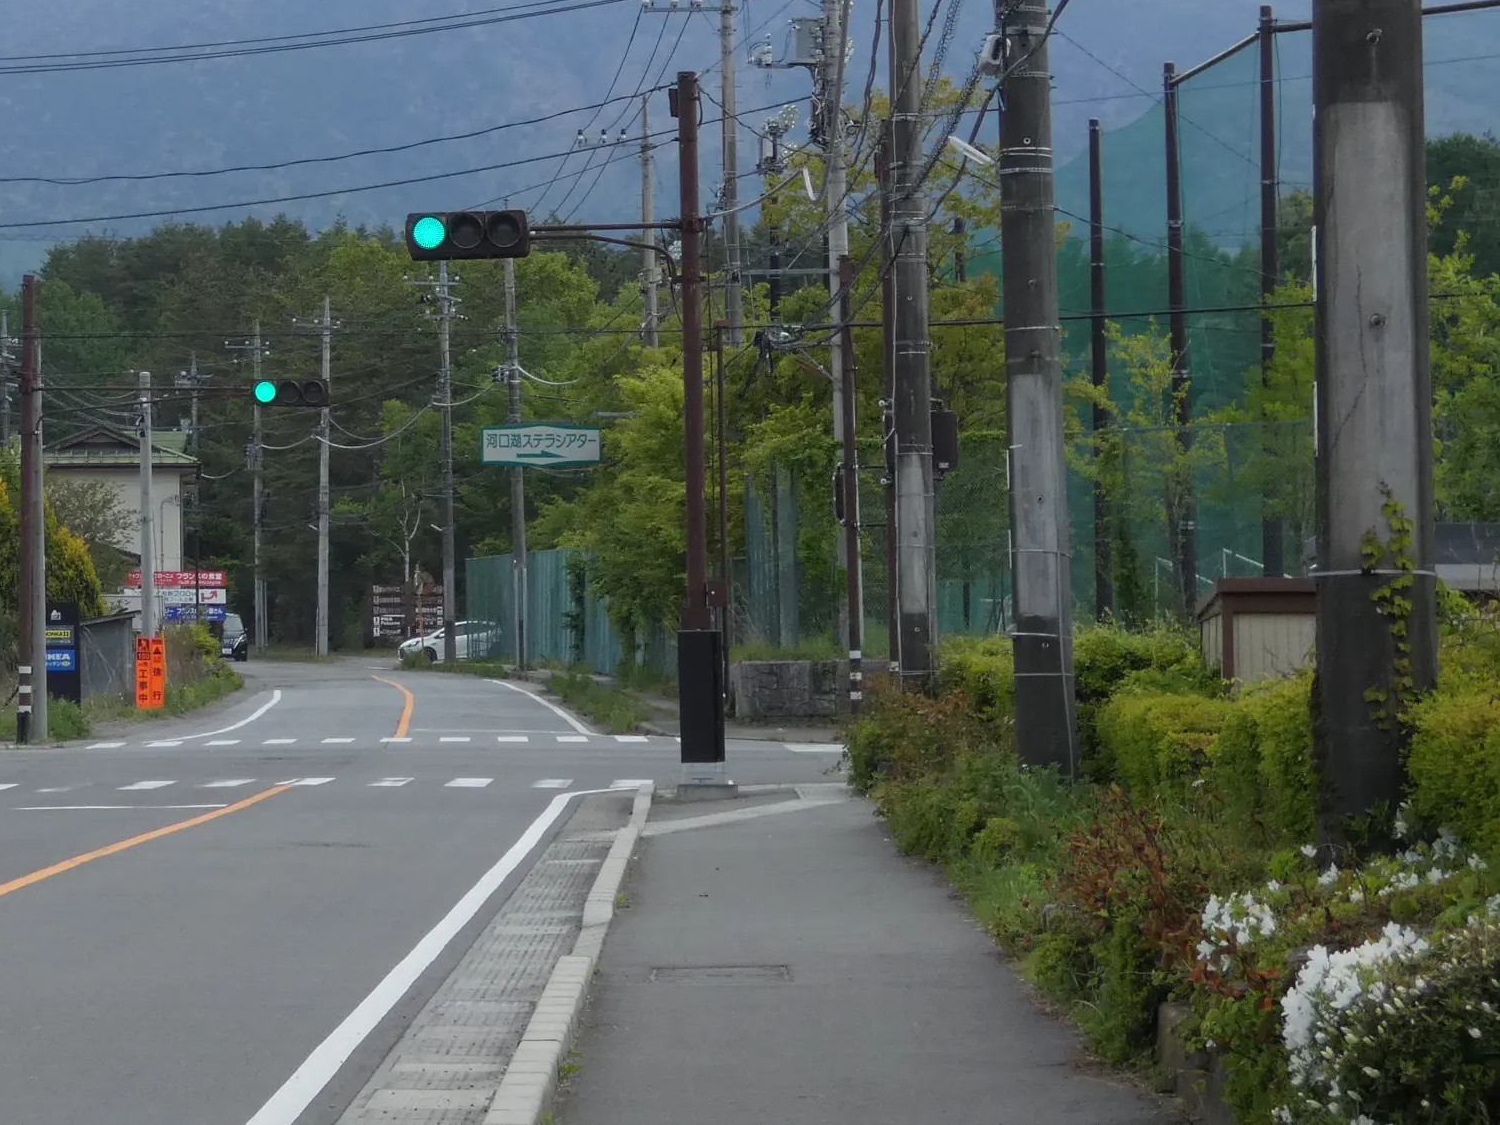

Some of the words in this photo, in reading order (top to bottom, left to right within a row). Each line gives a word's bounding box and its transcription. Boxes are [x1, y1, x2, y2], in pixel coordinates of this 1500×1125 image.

[486, 433, 597, 449] 河口湖ステラシアター
